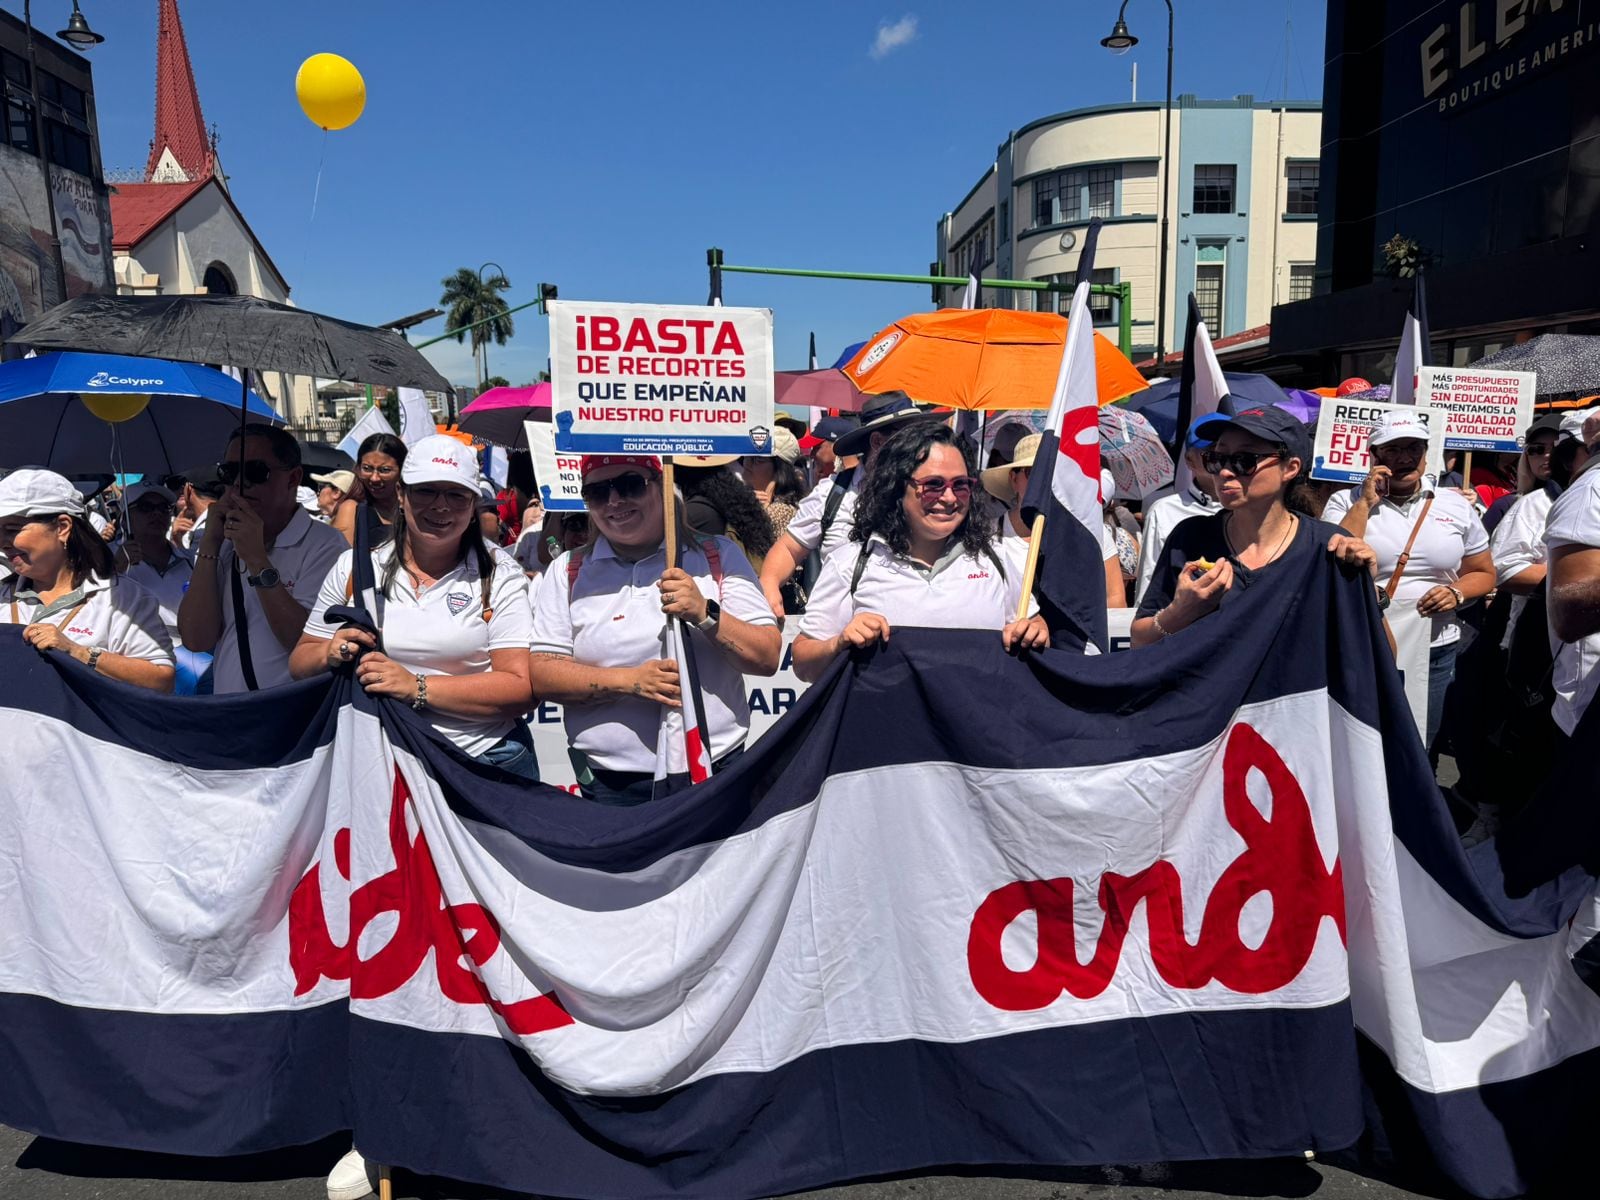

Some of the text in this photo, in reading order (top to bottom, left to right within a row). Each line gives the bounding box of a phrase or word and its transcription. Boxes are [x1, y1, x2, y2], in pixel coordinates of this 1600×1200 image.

[1439, 22, 1600, 112] BOUTIQUE AMERI
[576, 315, 745, 356] ¡BASTA
[577, 355, 746, 378] DE RECORTES
[108, 376, 164, 387] Colypro
[1432, 373, 1520, 387] MÁS PRESUPUESTO
[578, 381, 746, 404] QUE EMPEÑAN
[1431, 382, 1519, 395] MÁS OPORTUNIDADES
[1430, 392, 1519, 406] SIN EDUCACIÓN
[578, 407, 746, 424] NUESTRO FUTURO!
[1503, 407, 1517, 415] LA
[1333, 423, 1348, 433] ES
[1456, 425, 1515, 437] VIOLENCIA
[623, 442, 714, 452] EDUCACIÓN PÚBLICA
[1329, 450, 1354, 466] DE
[560, 473, 575, 481] NO
[562, 485, 579, 494] NO
[967, 570, 989, 579] ande
[967, 722, 1345, 1012] and
